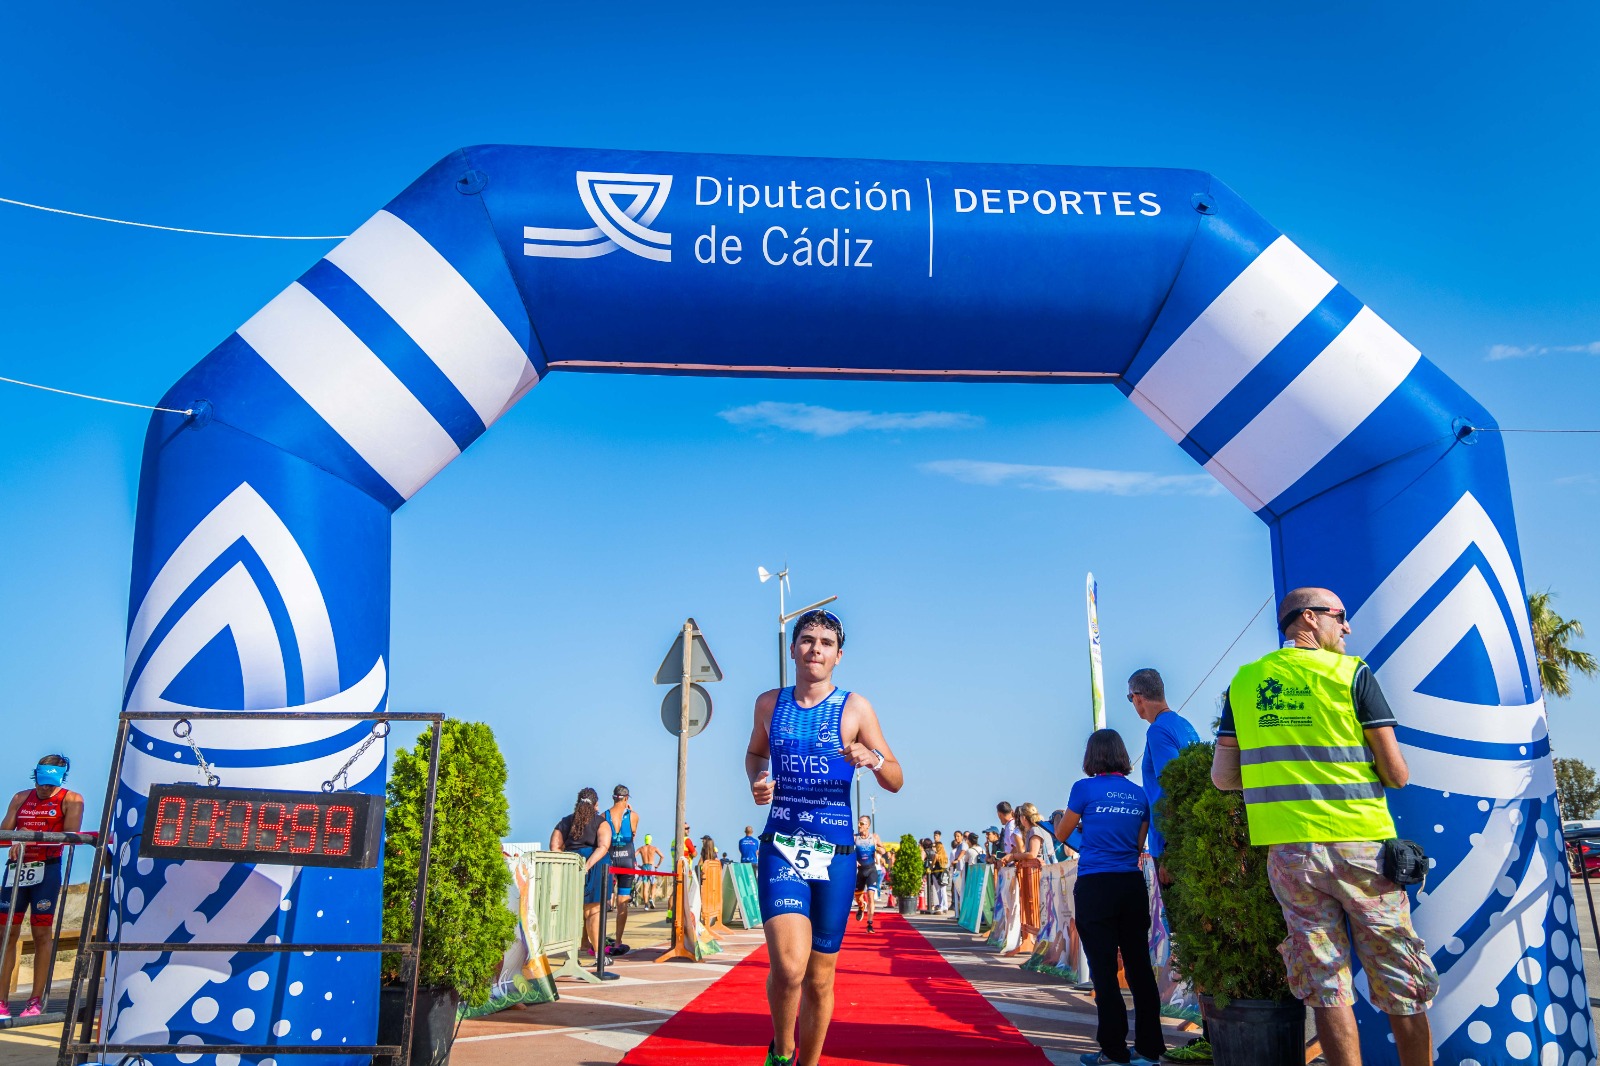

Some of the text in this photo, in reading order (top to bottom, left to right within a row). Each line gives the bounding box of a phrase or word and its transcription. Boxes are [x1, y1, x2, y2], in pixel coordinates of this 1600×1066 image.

[694, 175, 912, 213] Diputación
[953, 188, 1163, 217] DEPORTES
[695, 224, 874, 268] de Cádiz
[780, 754, 829, 774] REYES
[1106, 791, 1138, 800] OFICIAL
[795, 850, 811, 868] 5
